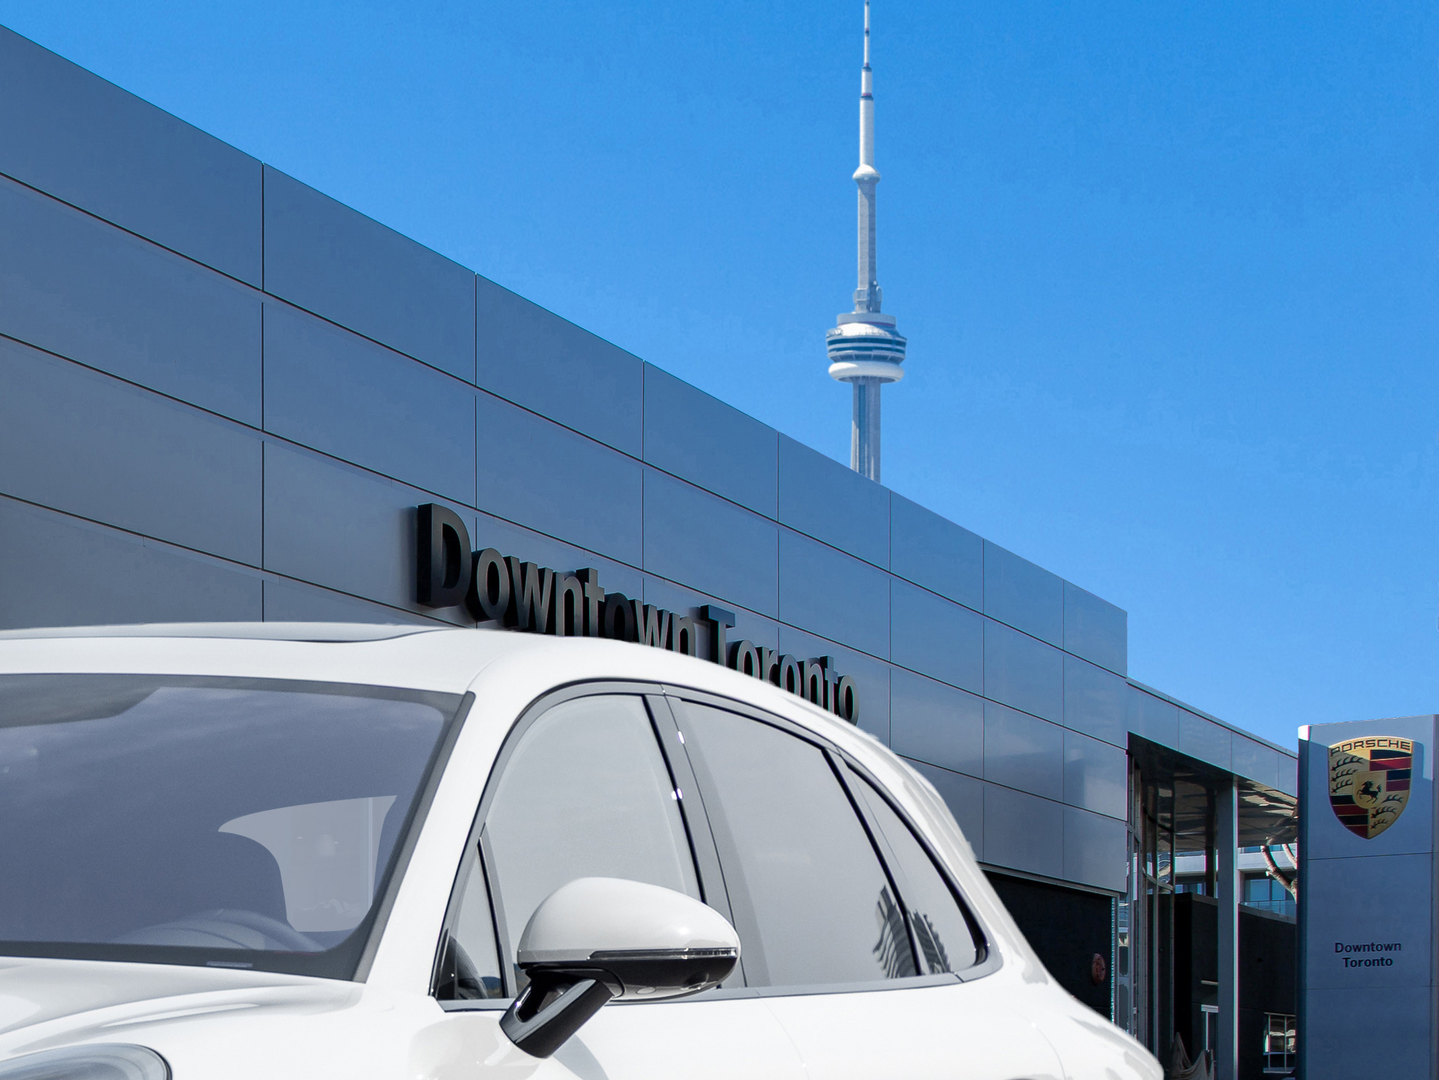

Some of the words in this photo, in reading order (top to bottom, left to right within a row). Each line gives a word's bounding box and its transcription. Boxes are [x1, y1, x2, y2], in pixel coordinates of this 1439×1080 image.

[417, 503, 696, 657] Downtown
[1330, 739, 1411, 757] PORSCHE
[1334, 942, 1402, 953] Downtown
[1342, 957, 1394, 968] Toronto
